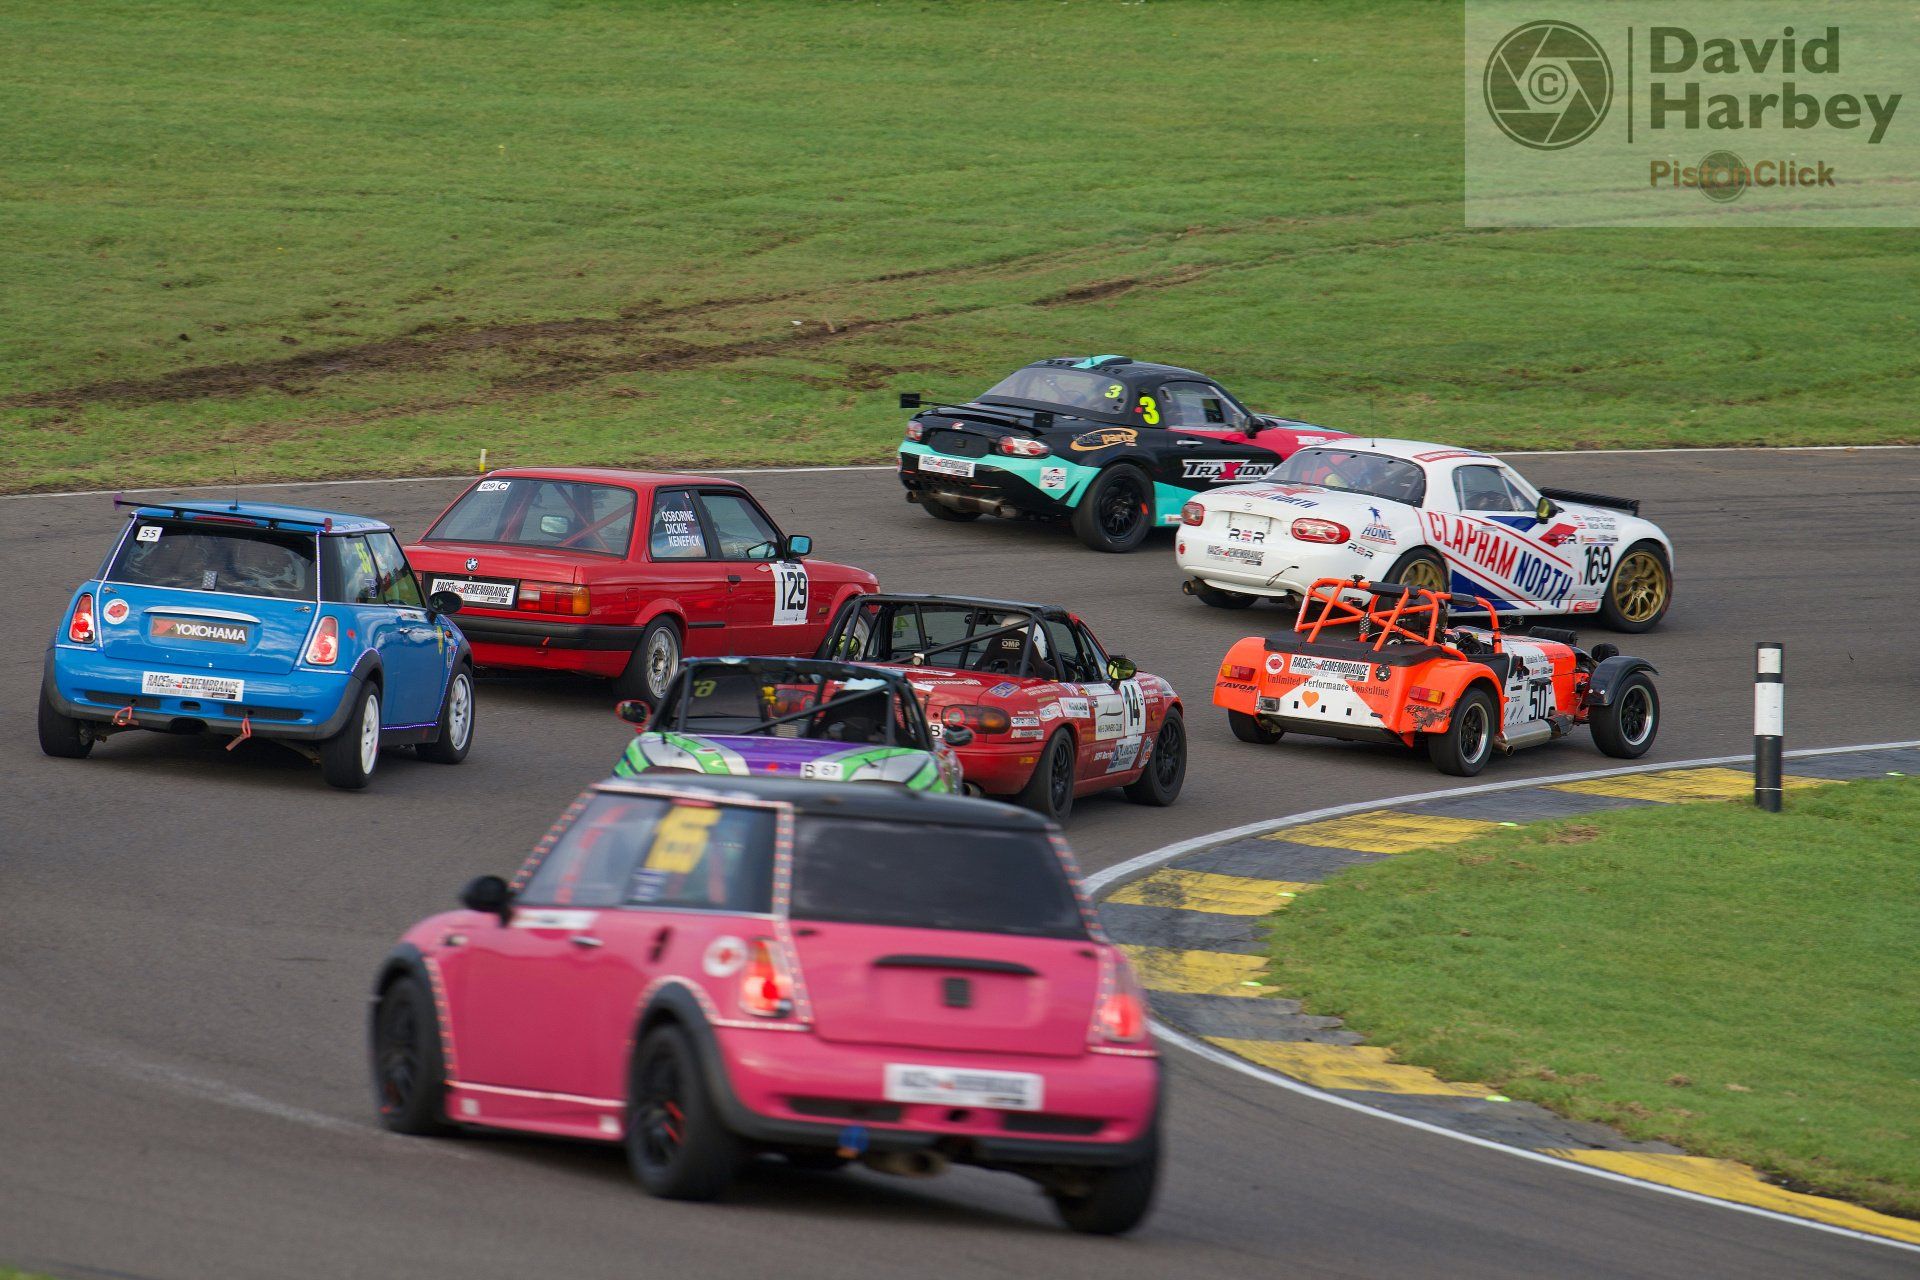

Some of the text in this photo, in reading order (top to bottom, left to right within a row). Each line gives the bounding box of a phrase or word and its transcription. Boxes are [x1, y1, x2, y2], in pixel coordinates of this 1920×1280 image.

[1105, 384, 1123, 398] 3
[1139, 396, 1160, 425] 3
[482, 482, 508, 490] 129 C
[661, 510, 695, 522] OSBORNE
[141, 529, 157, 538] 55
[665, 523, 688, 534] DICKIE
[1362, 526, 1396, 541] HOME
[668, 535, 701, 547] KENEFICK
[1427, 511, 1573, 609] CLAPHAM NORTH
[1584, 545, 1612, 587] 169
[435, 581, 454, 592] RACE
[464, 583, 512, 598] REMEMBRANCE
[780, 571, 808, 611] 129
[175, 623, 246, 641] YOKOHAMA
[1001, 640, 1020, 649] OMP
[1291, 656, 1311, 669] RACE
[1321, 659, 1370, 676] REMEMBRANCE
[147, 674, 169, 688] RACE
[181, 676, 240, 694] REMEMBRANCE
[1268, 674, 1390, 697] Unlimited Performance Consulting
[1123, 684, 1141, 727] 14
[1529, 684, 1547, 721] 50
[804, 764, 837, 779] B 67
